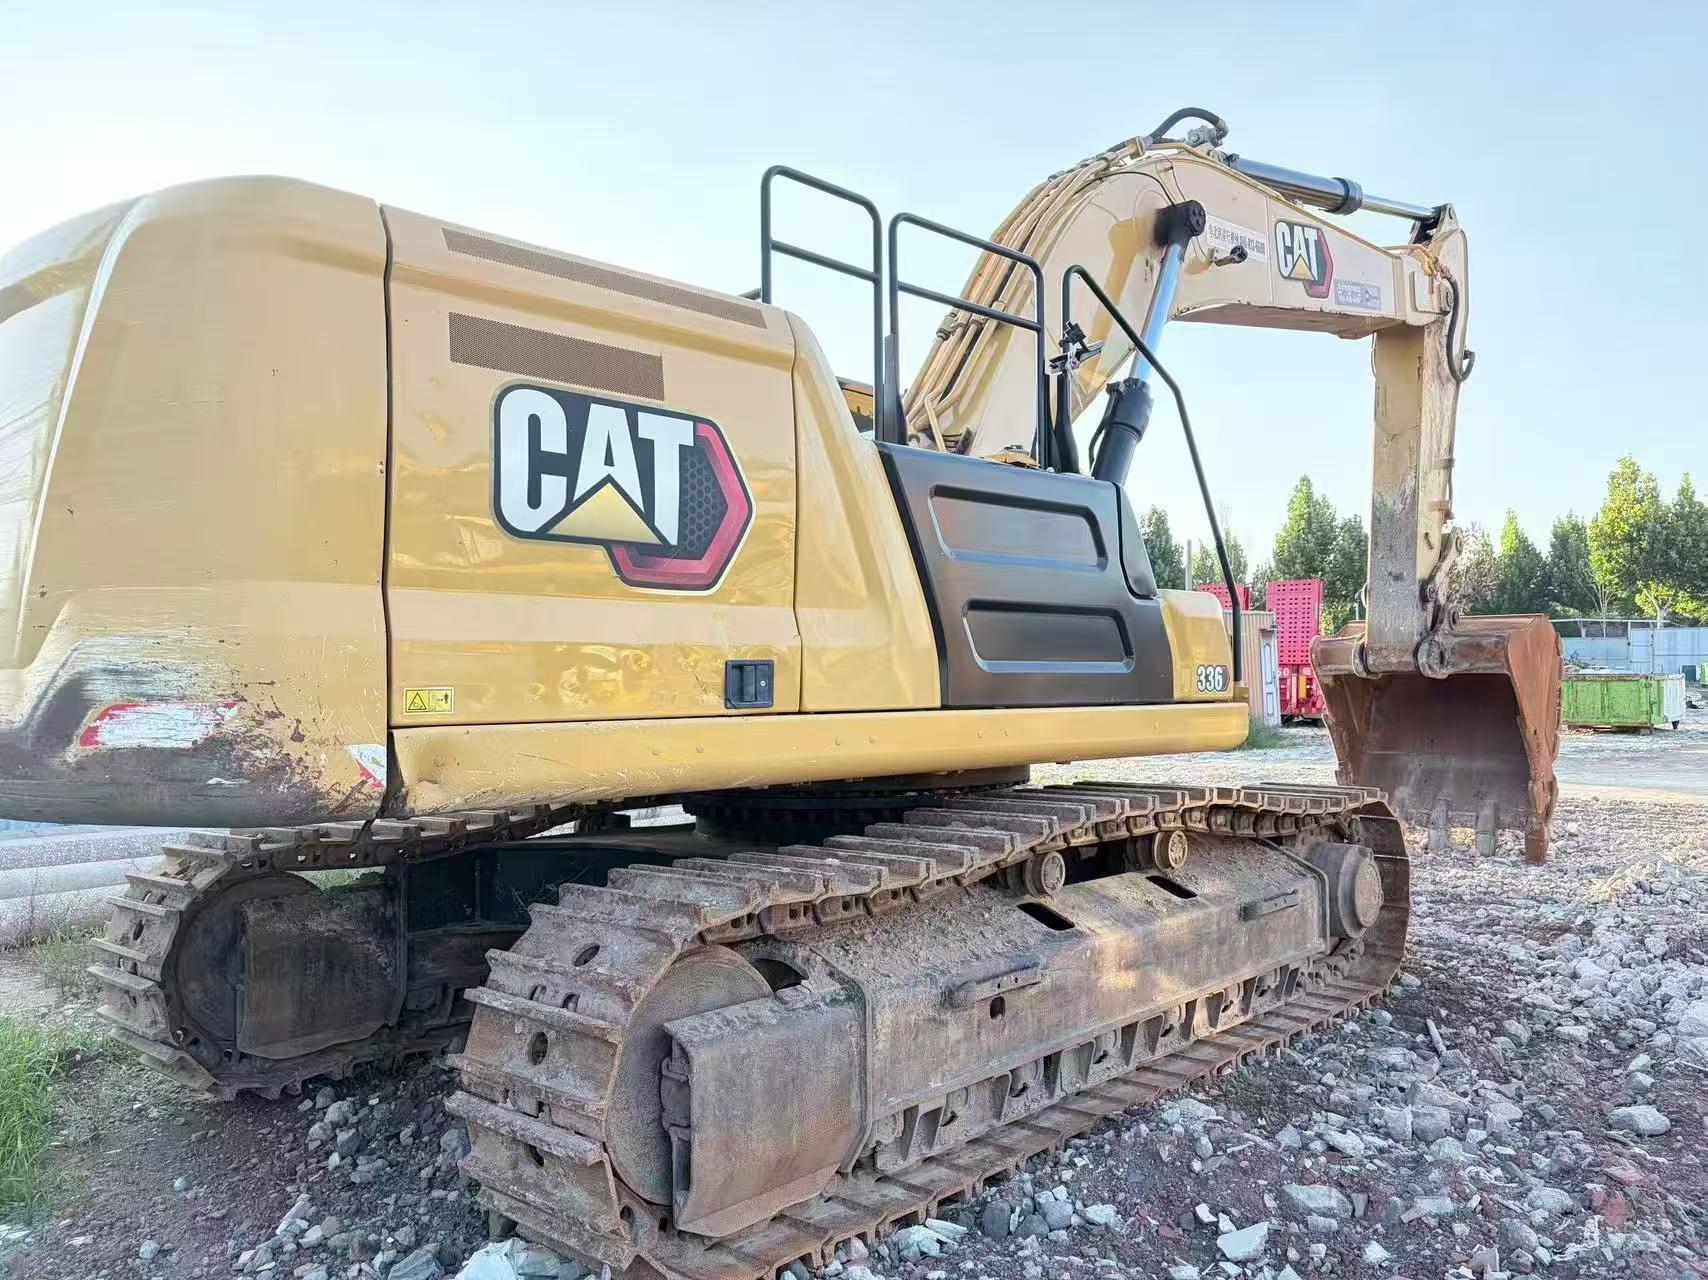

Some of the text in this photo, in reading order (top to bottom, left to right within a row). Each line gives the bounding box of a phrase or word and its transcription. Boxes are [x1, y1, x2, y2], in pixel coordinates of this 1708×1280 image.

[1276, 221, 1319, 281] CAT
[499, 388, 695, 546] CAT
[1197, 665, 1223, 691] 336
